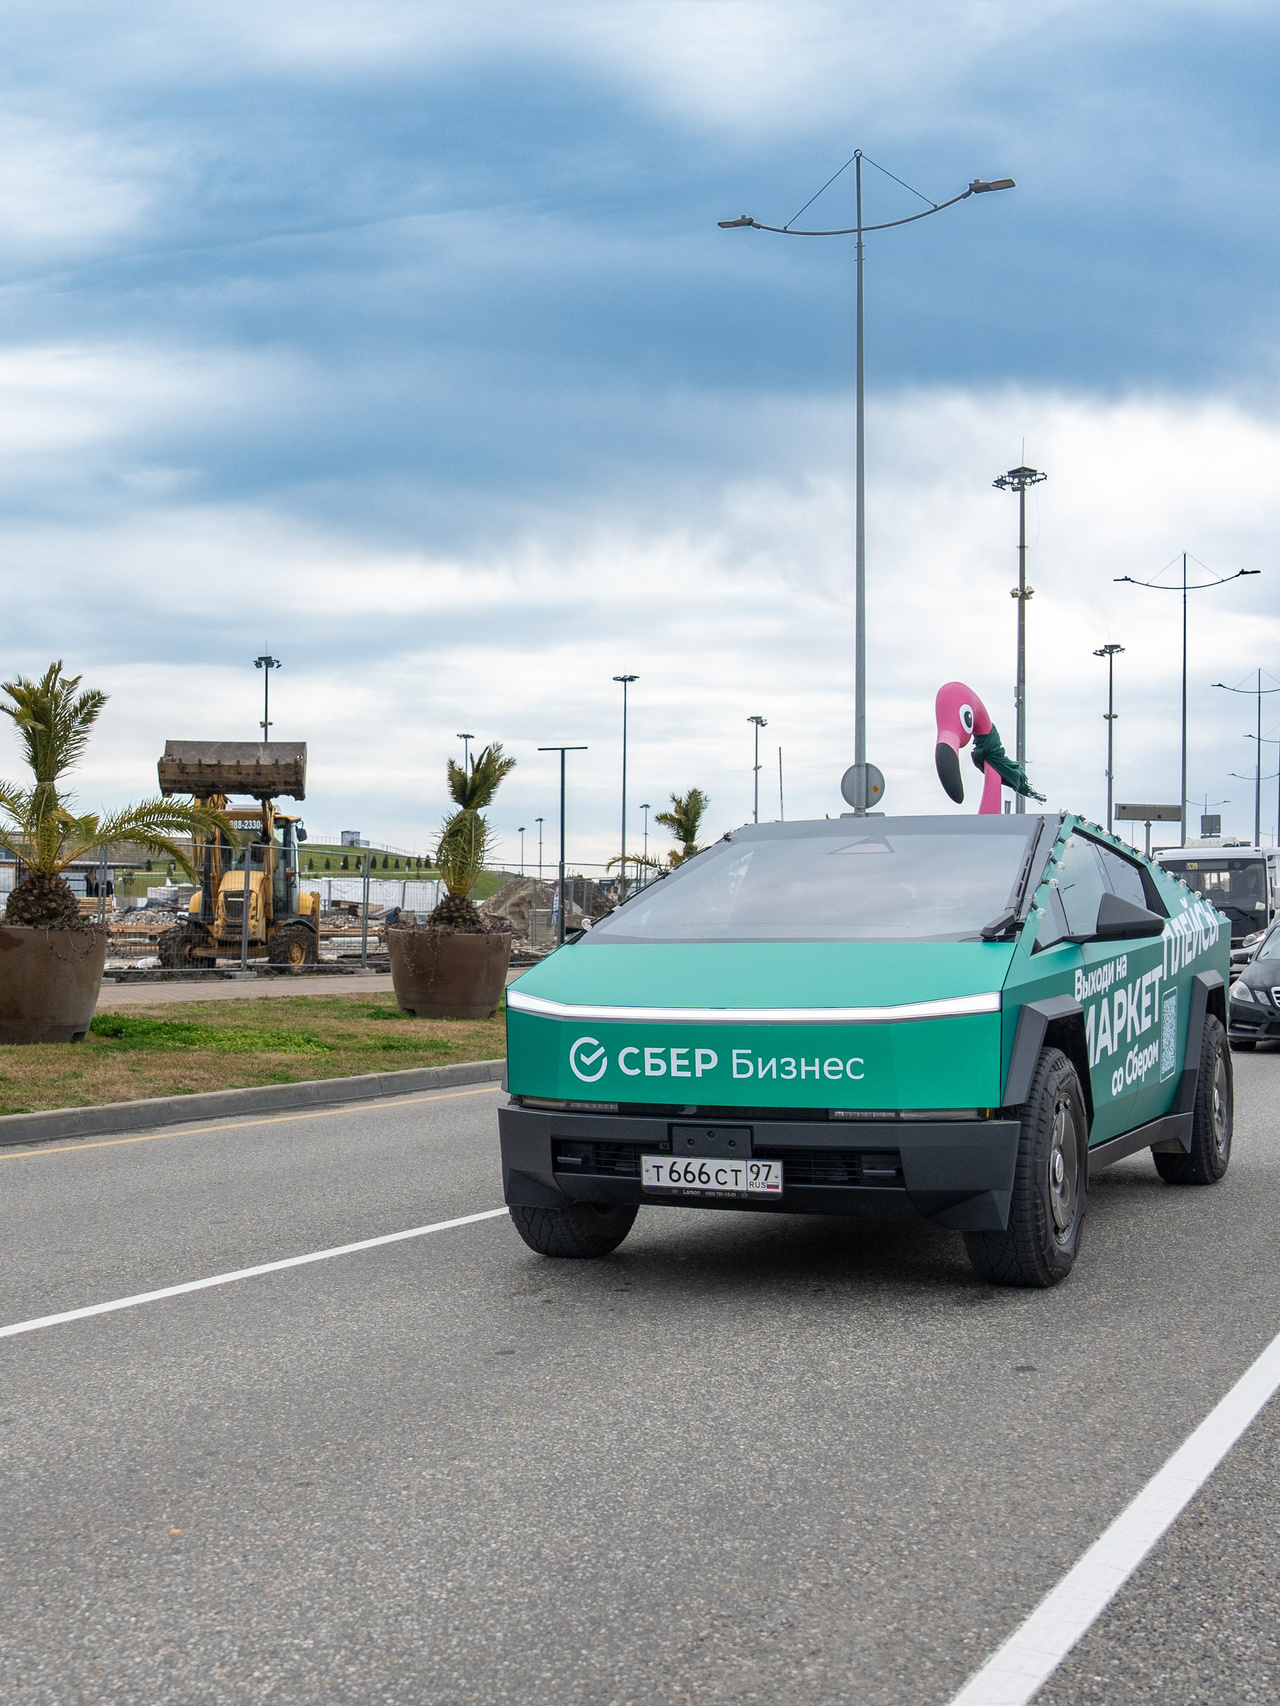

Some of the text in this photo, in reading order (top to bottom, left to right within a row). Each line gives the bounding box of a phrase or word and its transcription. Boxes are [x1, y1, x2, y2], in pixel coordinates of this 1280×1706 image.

[1075, 954, 1128, 1002] Выходи на
[618, 1046, 865, 1080] СБЕР Бизнес
[1112, 1039, 1159, 1096] со Сбером
[749, 1163, 773, 1182] 97
[749, 1181, 767, 1189] RUS
[682, 1188, 701, 1196] Larson
